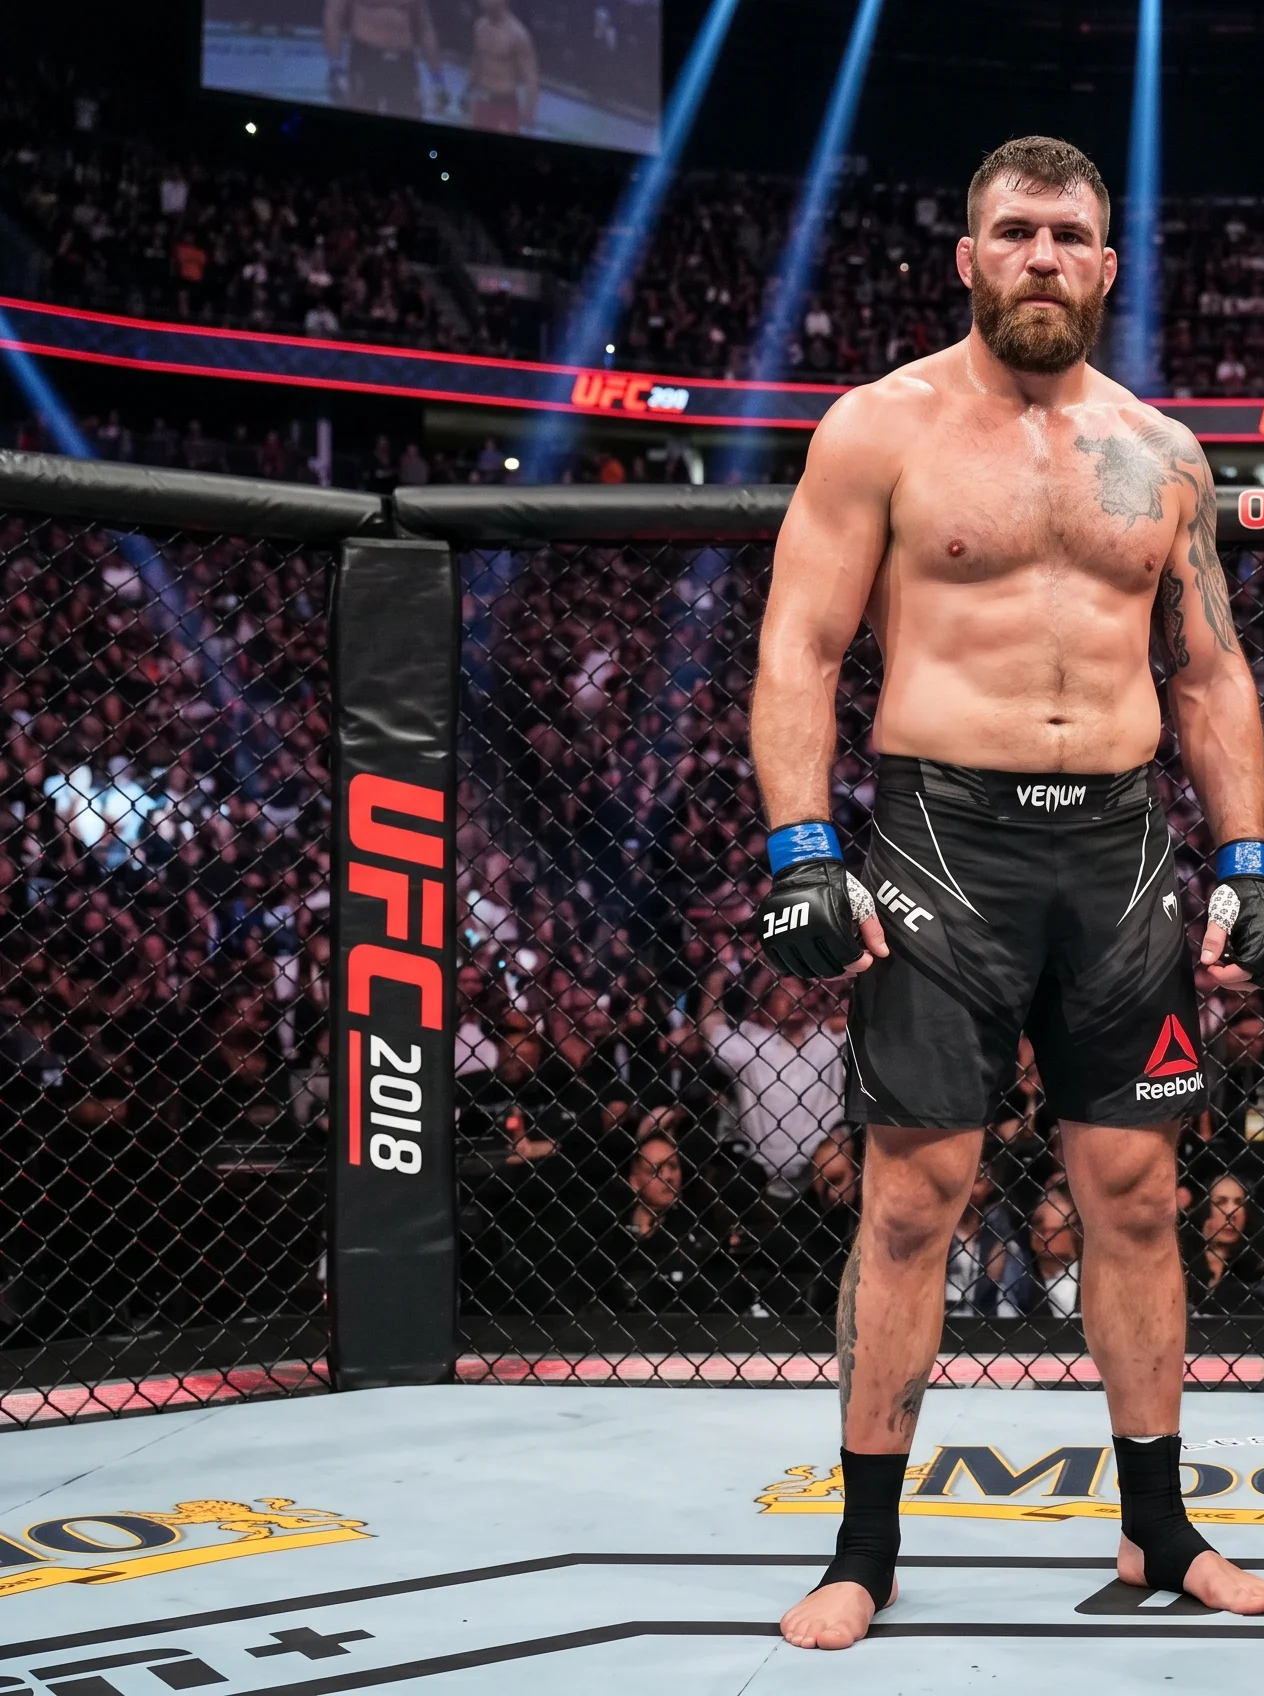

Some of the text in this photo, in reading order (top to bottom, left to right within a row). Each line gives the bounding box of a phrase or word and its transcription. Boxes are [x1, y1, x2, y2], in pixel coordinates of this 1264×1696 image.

[571, 374, 653, 412] UFC
[1016, 785, 1087, 812] VENUM
[763, 901, 810, 939] UFC
[876, 880, 934, 933] UFC
[348, 773, 444, 1175] UFC 2018
[1135, 1071, 1205, 1101] Reebok
